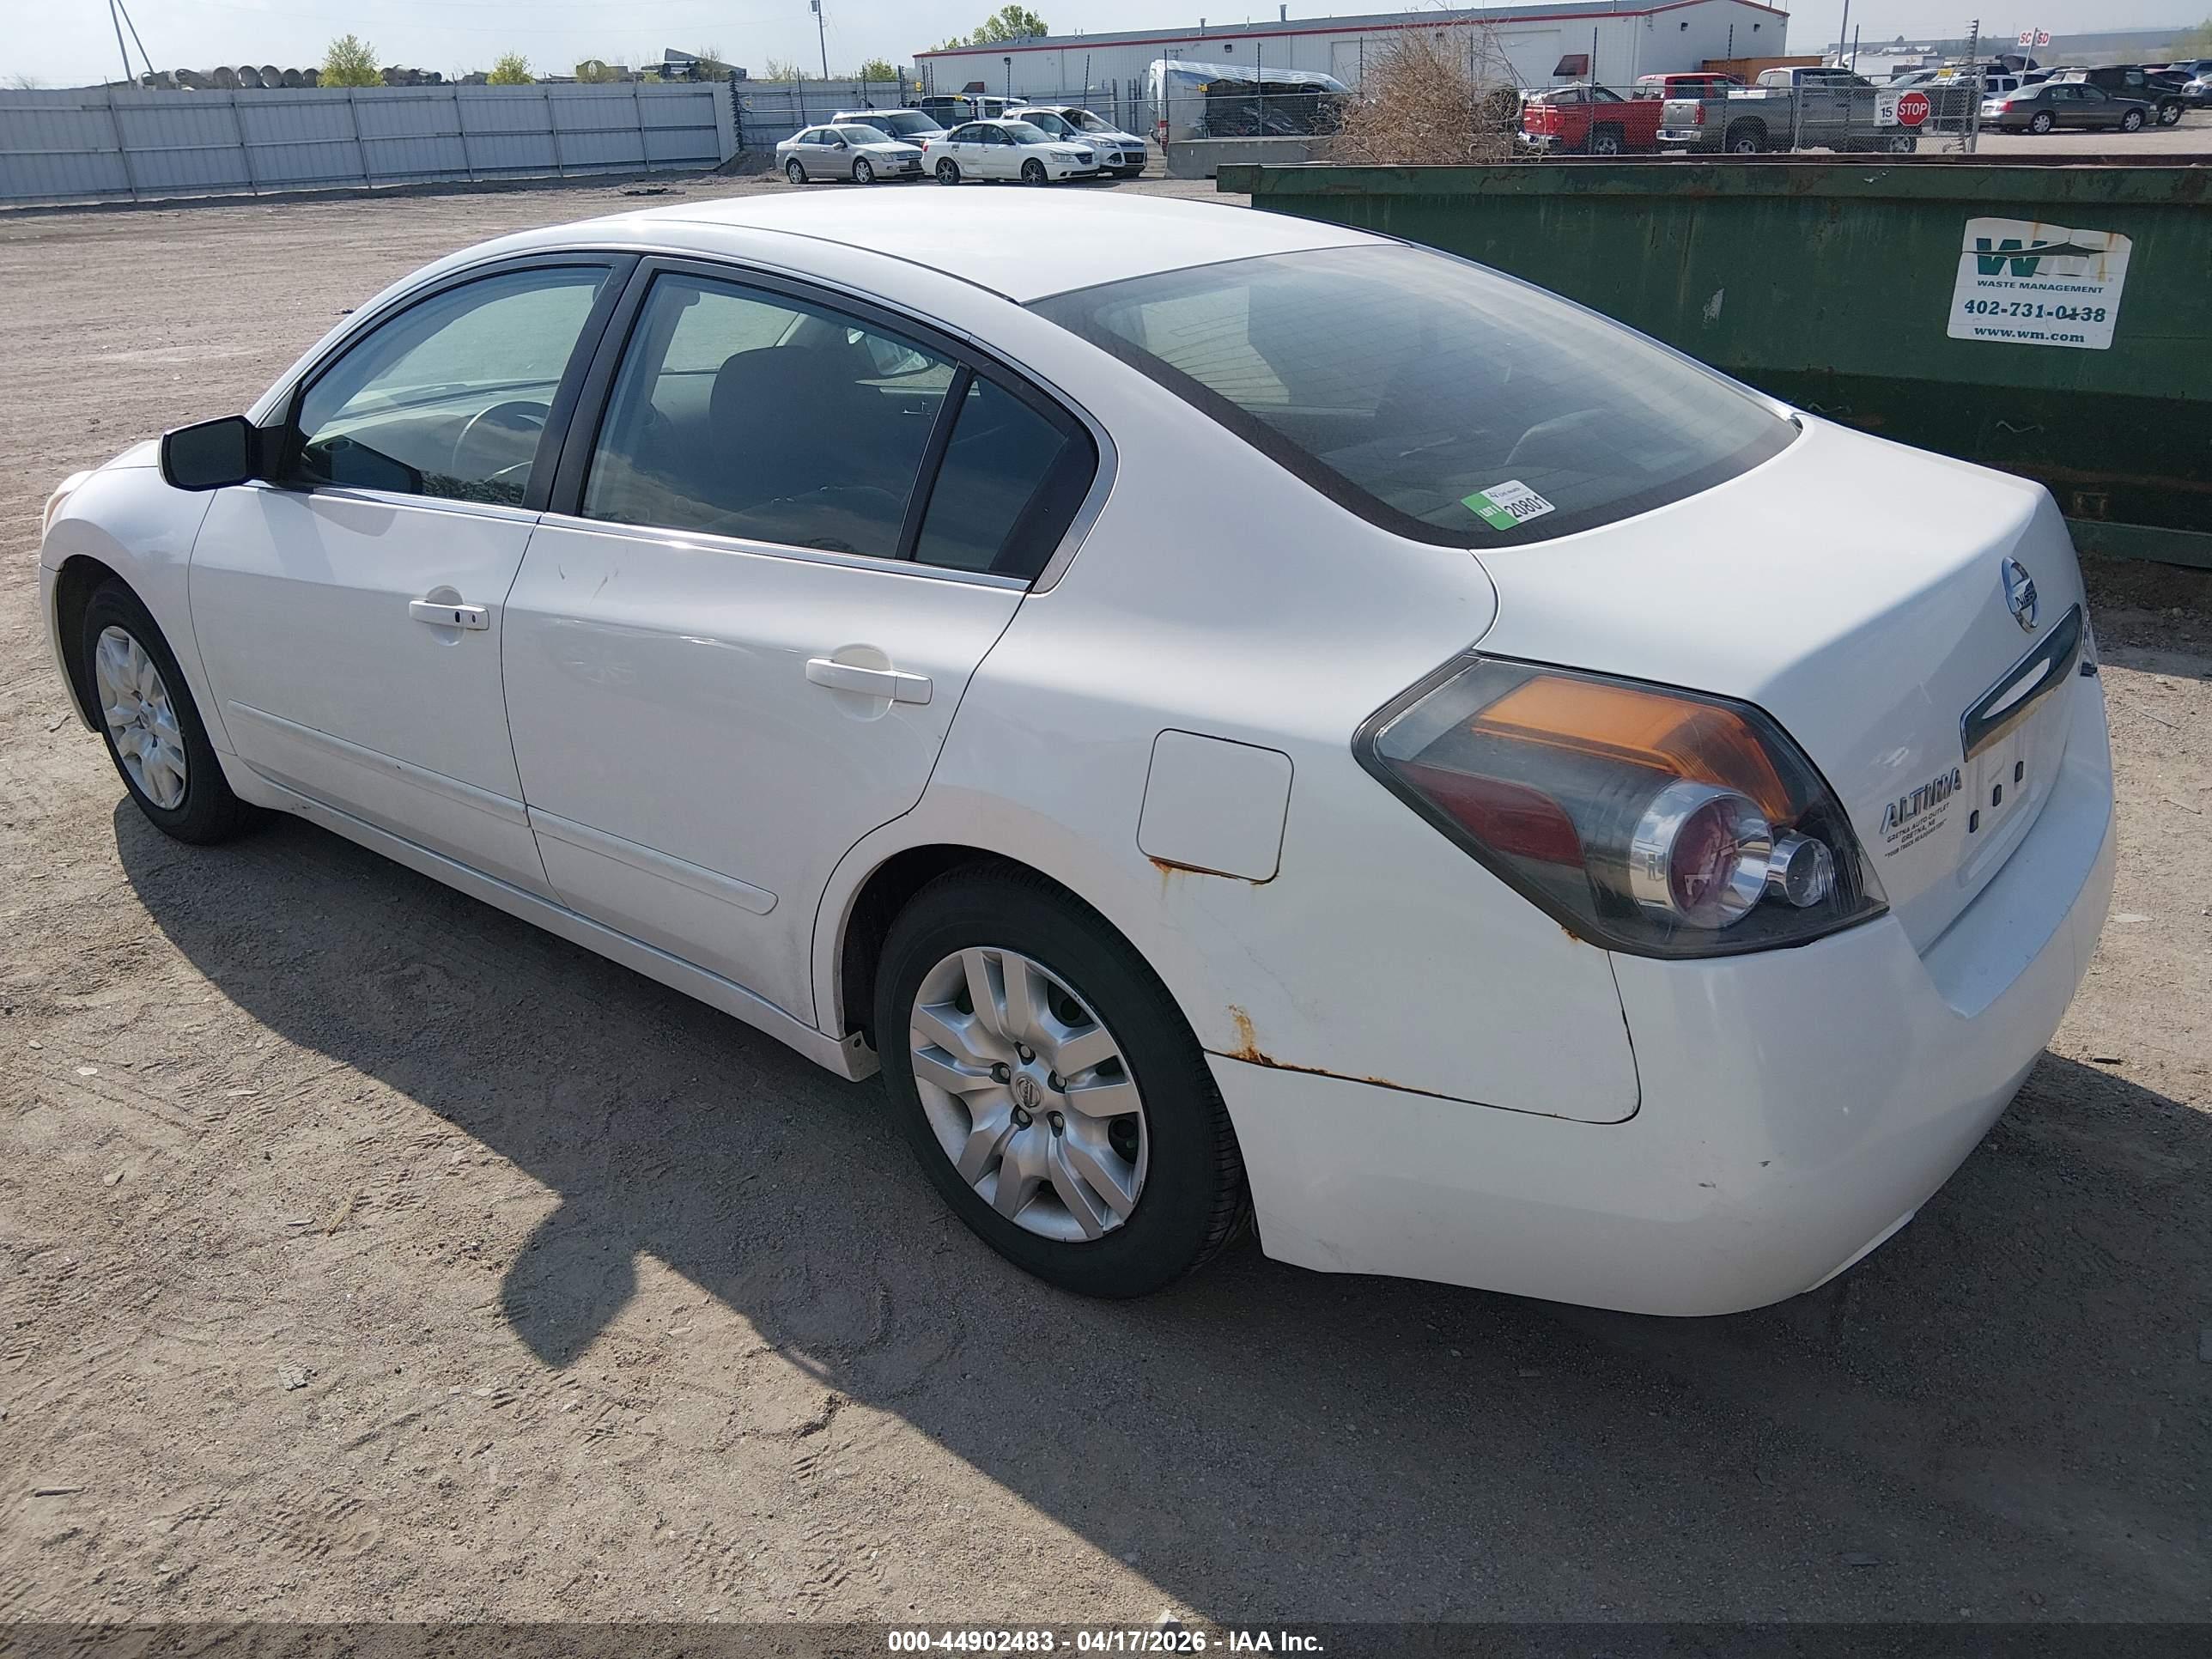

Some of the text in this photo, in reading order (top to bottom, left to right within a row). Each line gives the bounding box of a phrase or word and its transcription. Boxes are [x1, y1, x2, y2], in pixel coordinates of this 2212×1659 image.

[2020, 33, 2032, 44] SC
[2037, 33, 2050, 44] SD
[1881, 106, 1893, 118] 15
[1899, 102, 1929, 116] STOP
[1977, 280, 2105, 294] WASTE MANAGEMENT
[1964, 299, 2106, 324] 402-731-0138
[1974, 326, 2085, 343] www.wm.com
[1504, 495, 1550, 518] 20801
[1879, 767, 1963, 834] ALTIMA
[1887, 802, 1950, 843] GRETNA AUTO OUTLET
